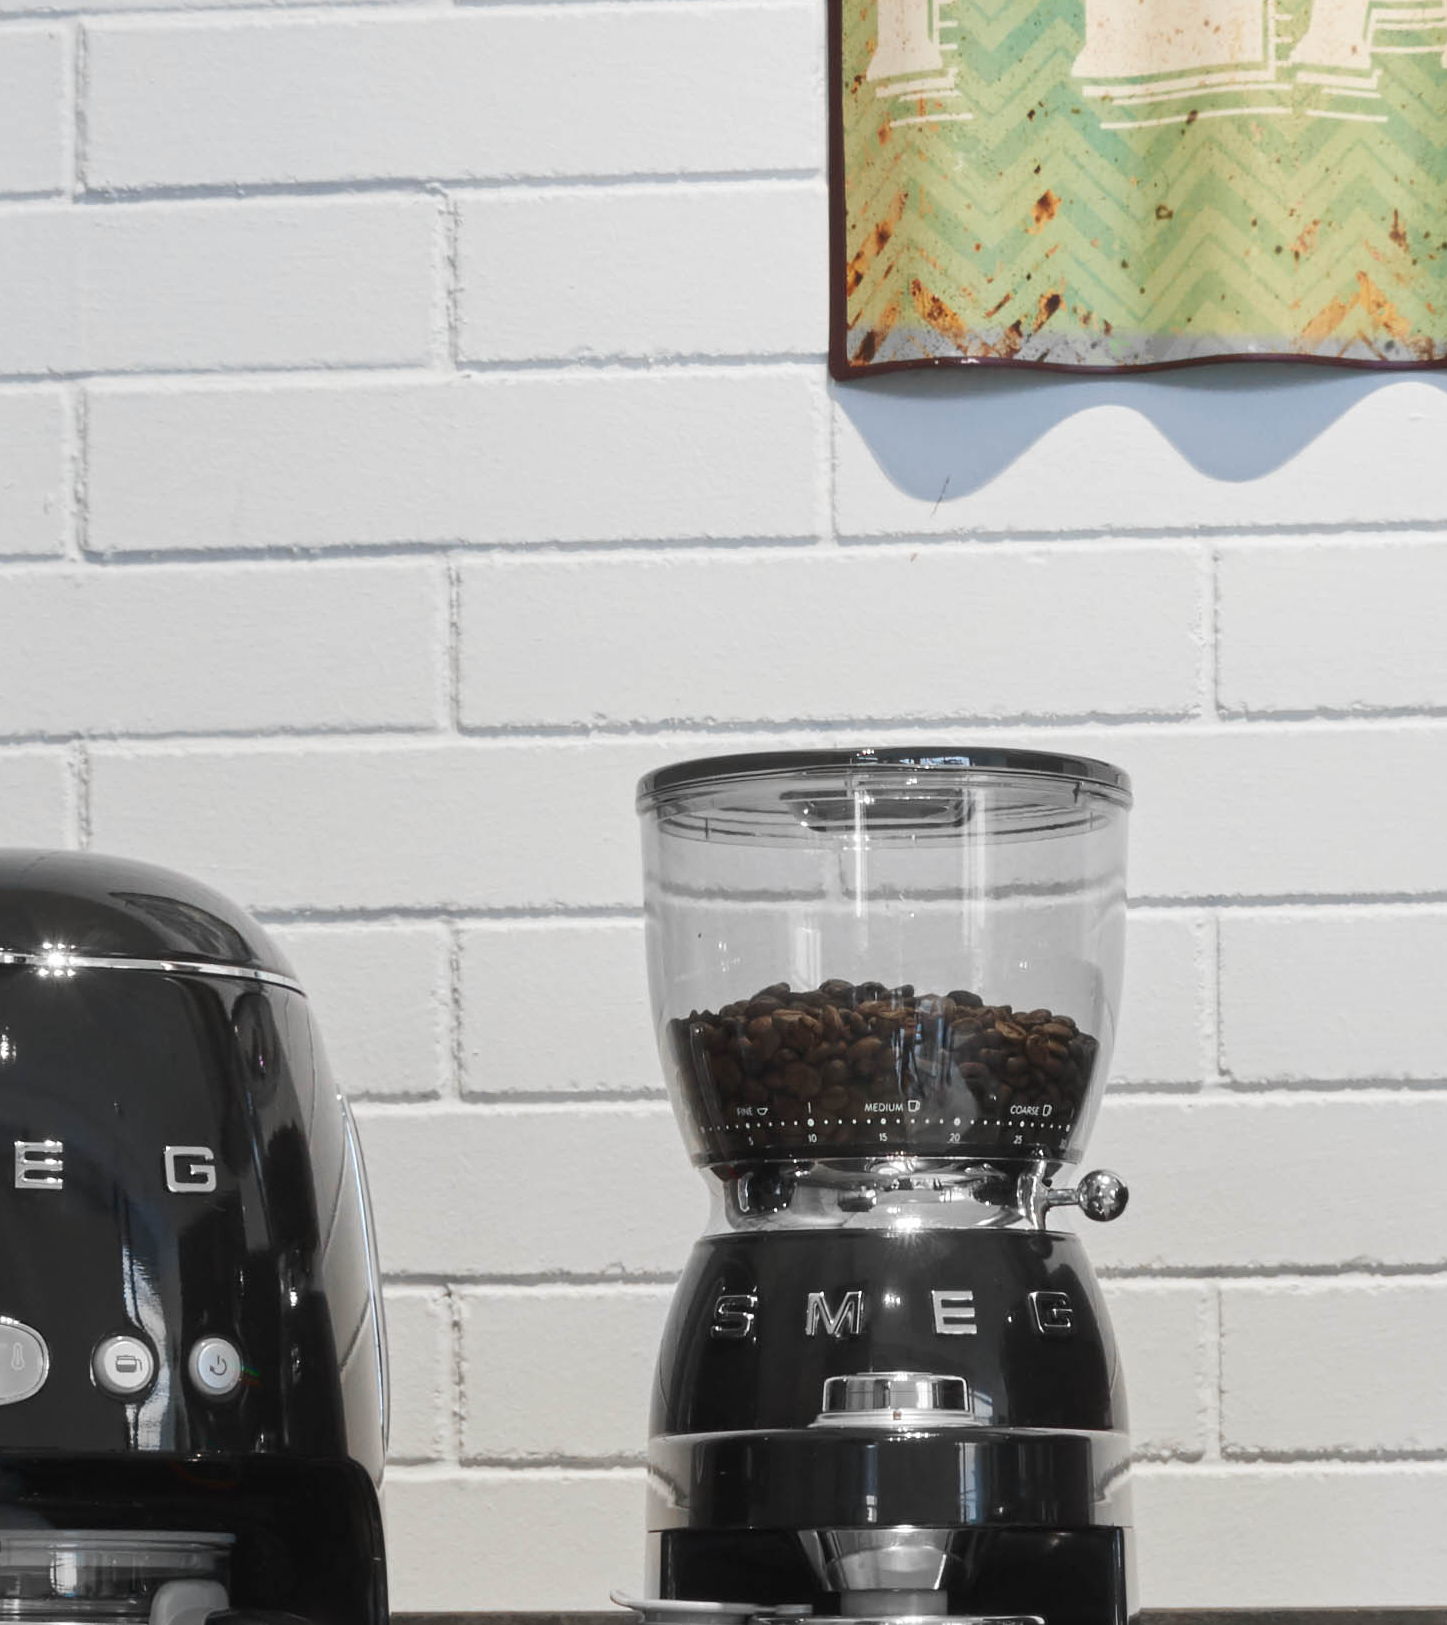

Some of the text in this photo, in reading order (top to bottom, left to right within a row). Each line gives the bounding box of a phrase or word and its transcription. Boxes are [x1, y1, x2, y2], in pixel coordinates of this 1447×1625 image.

[736, 1102, 1040, 1117] FINE MEDIUM COARSE
[807, 1133, 818, 1144] 10
[878, 1132, 888, 1143] 15
[948, 1132, 961, 1144] 20
[1013, 1134, 1023, 1146] 25
[709, 1288, 1076, 1339] SMEG
